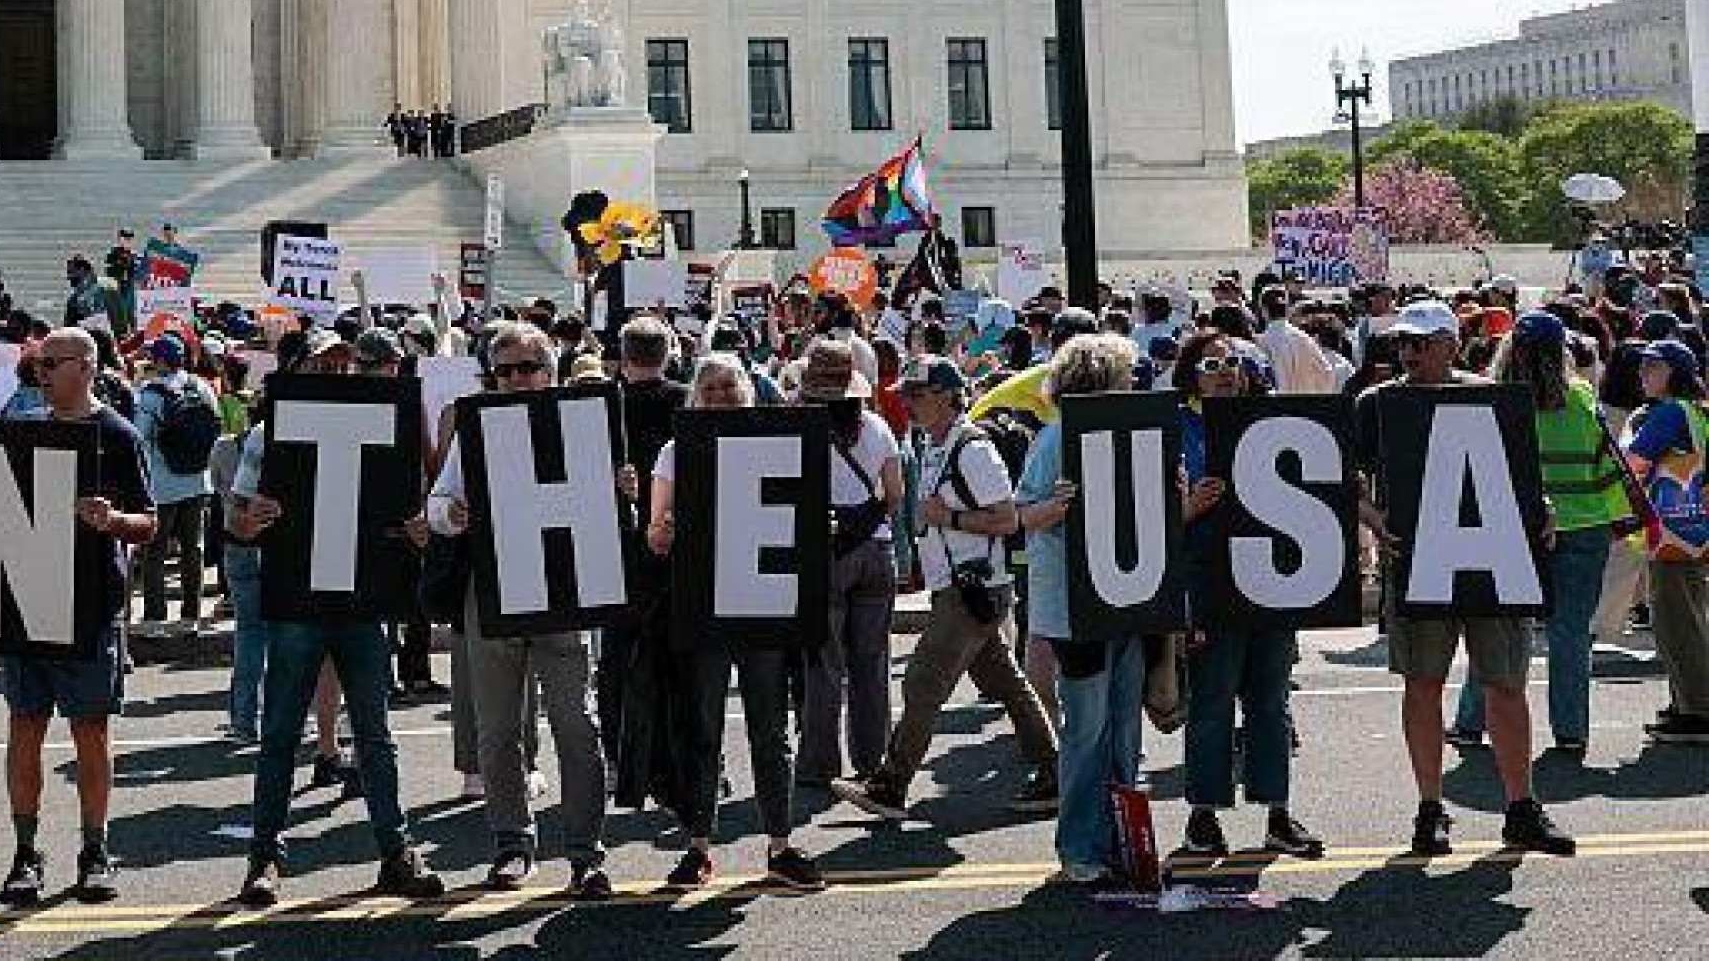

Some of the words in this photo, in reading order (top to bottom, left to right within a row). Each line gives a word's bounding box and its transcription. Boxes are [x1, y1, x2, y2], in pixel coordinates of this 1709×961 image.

[277, 276, 336, 303] ALL
[272, 396, 803, 619] THE
[1080, 402, 1545, 609] USA
